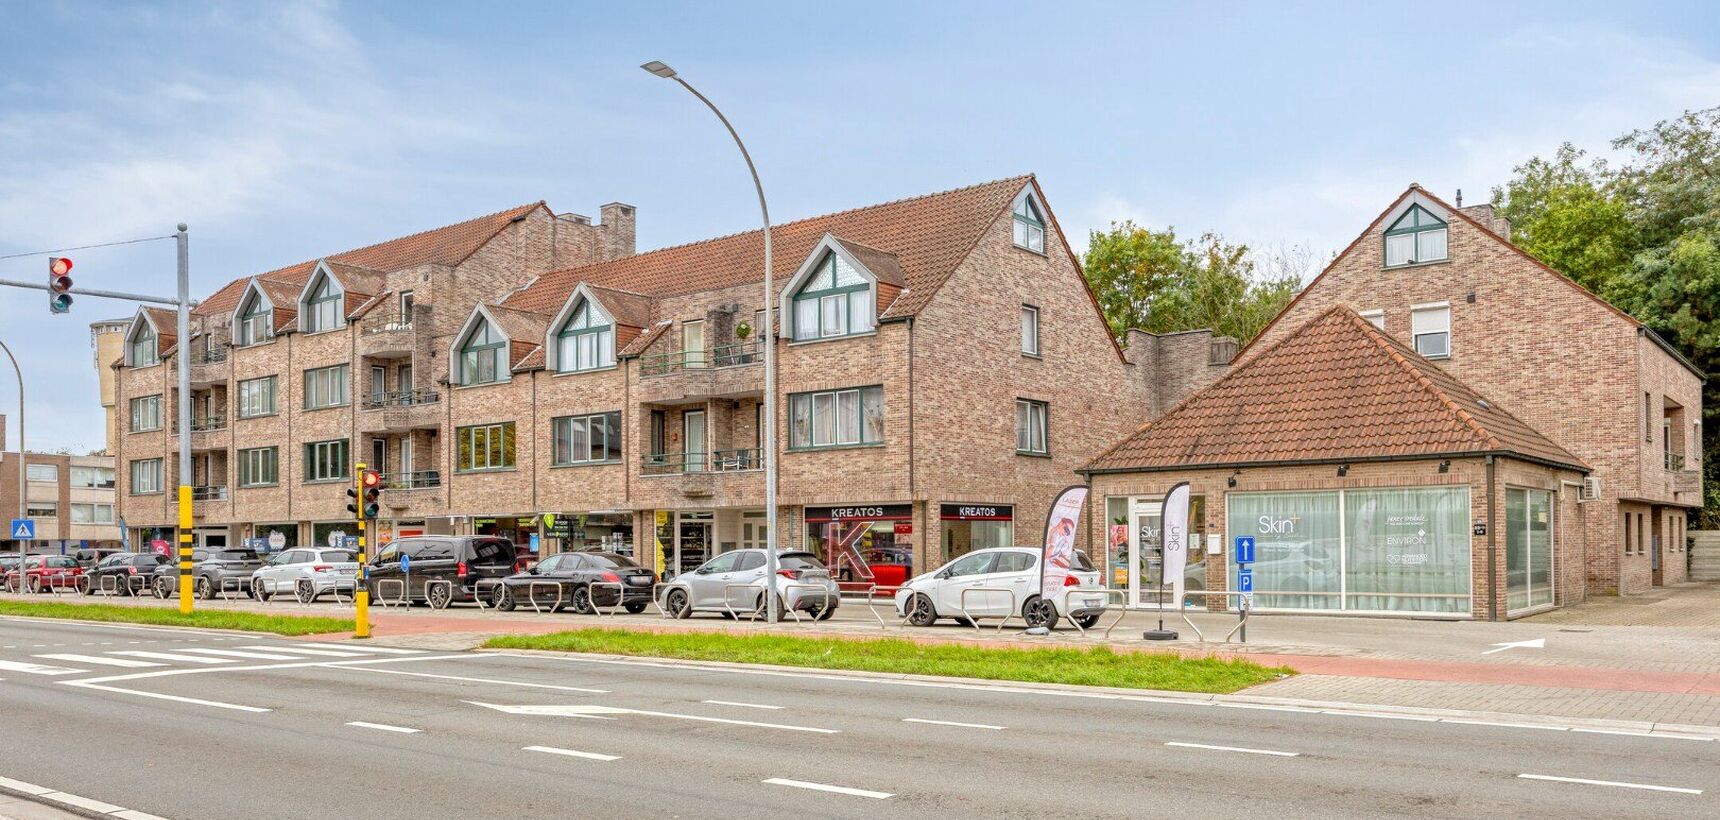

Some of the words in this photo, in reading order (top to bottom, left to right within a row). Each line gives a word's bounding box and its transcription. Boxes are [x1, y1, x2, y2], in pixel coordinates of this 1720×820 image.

[831, 507, 884, 517] KREATOS
[959, 507, 996, 517] KREATOS
[1387, 536, 1426, 545] ENVIRON
[1242, 576, 1250, 591] P
